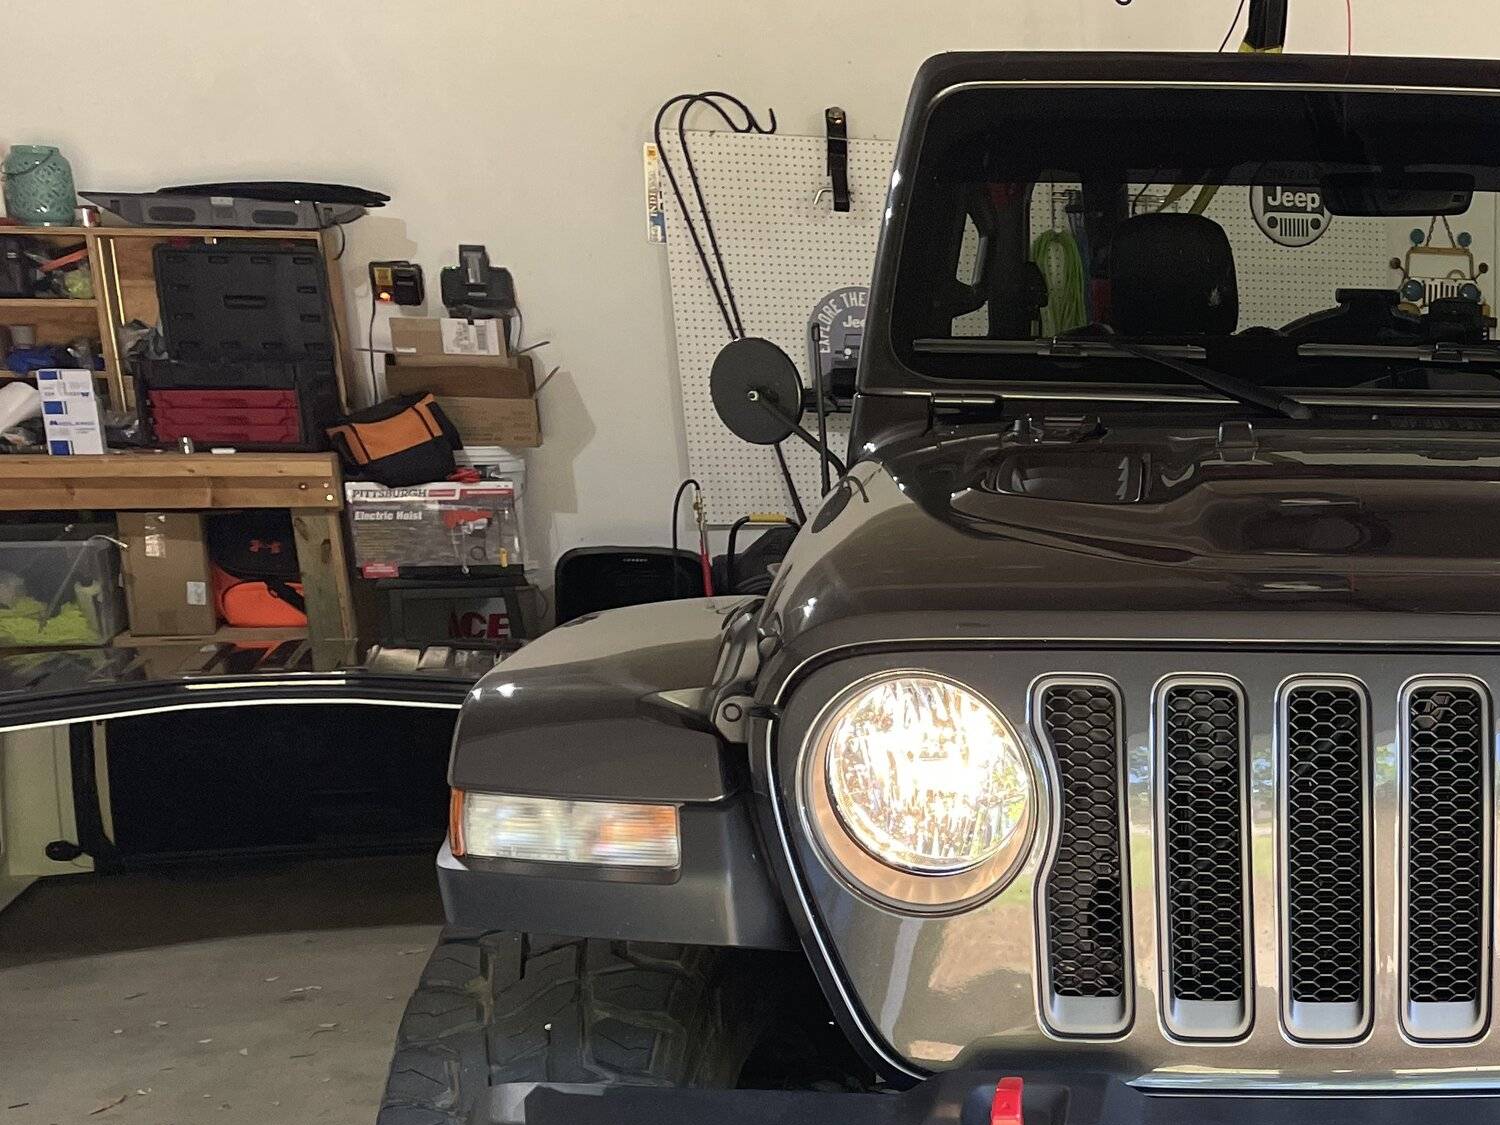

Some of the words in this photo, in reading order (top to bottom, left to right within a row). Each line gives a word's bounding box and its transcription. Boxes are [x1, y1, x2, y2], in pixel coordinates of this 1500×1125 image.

[1267, 186, 1320, 212] Jeep
[819, 299, 842, 353] EXPLORE
[840, 291, 867, 308] THE
[352, 488, 428, 499] PITTSBURGH
[354, 511, 394, 521] Electric
[396, 511, 423, 521] Hoist
